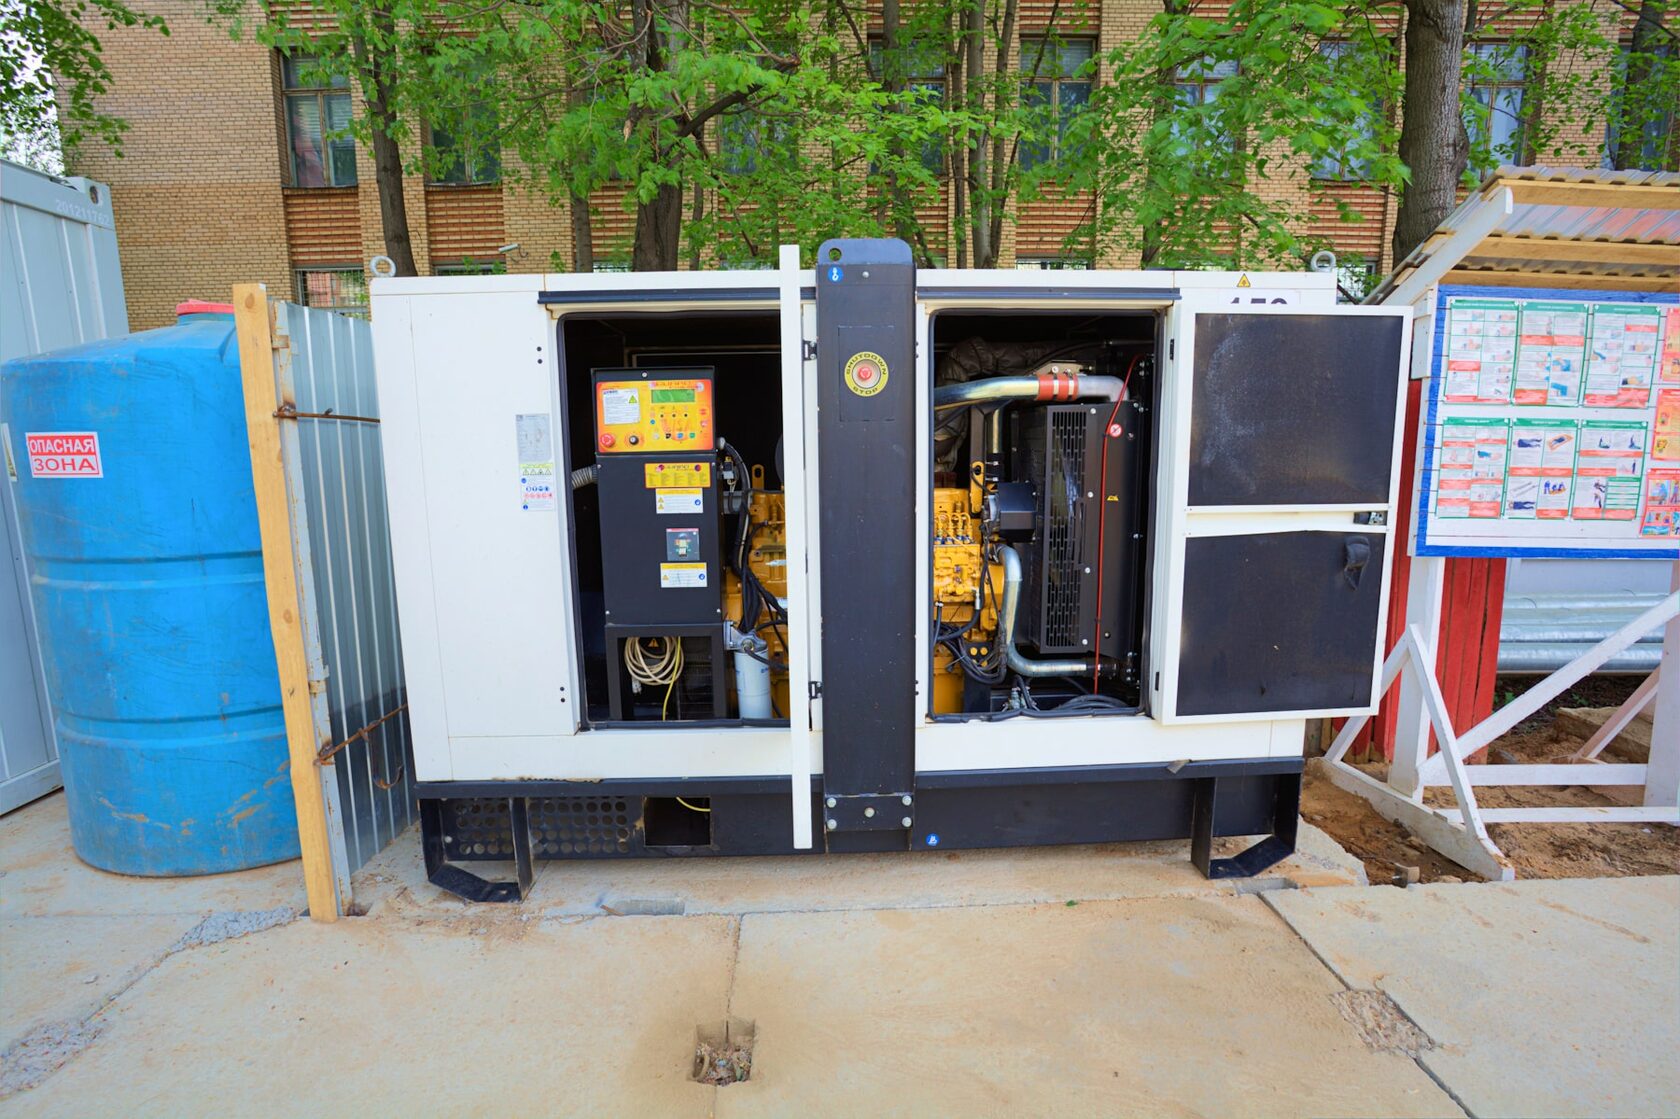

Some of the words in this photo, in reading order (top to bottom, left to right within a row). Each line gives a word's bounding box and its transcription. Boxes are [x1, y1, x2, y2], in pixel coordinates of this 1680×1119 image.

[846, 353, 887, 375] SHUTDOWN
[853, 386, 878, 395] STOP
[29, 438, 95, 453] ОПАСНАЯ
[34, 458, 96, 471] ЗОНА
